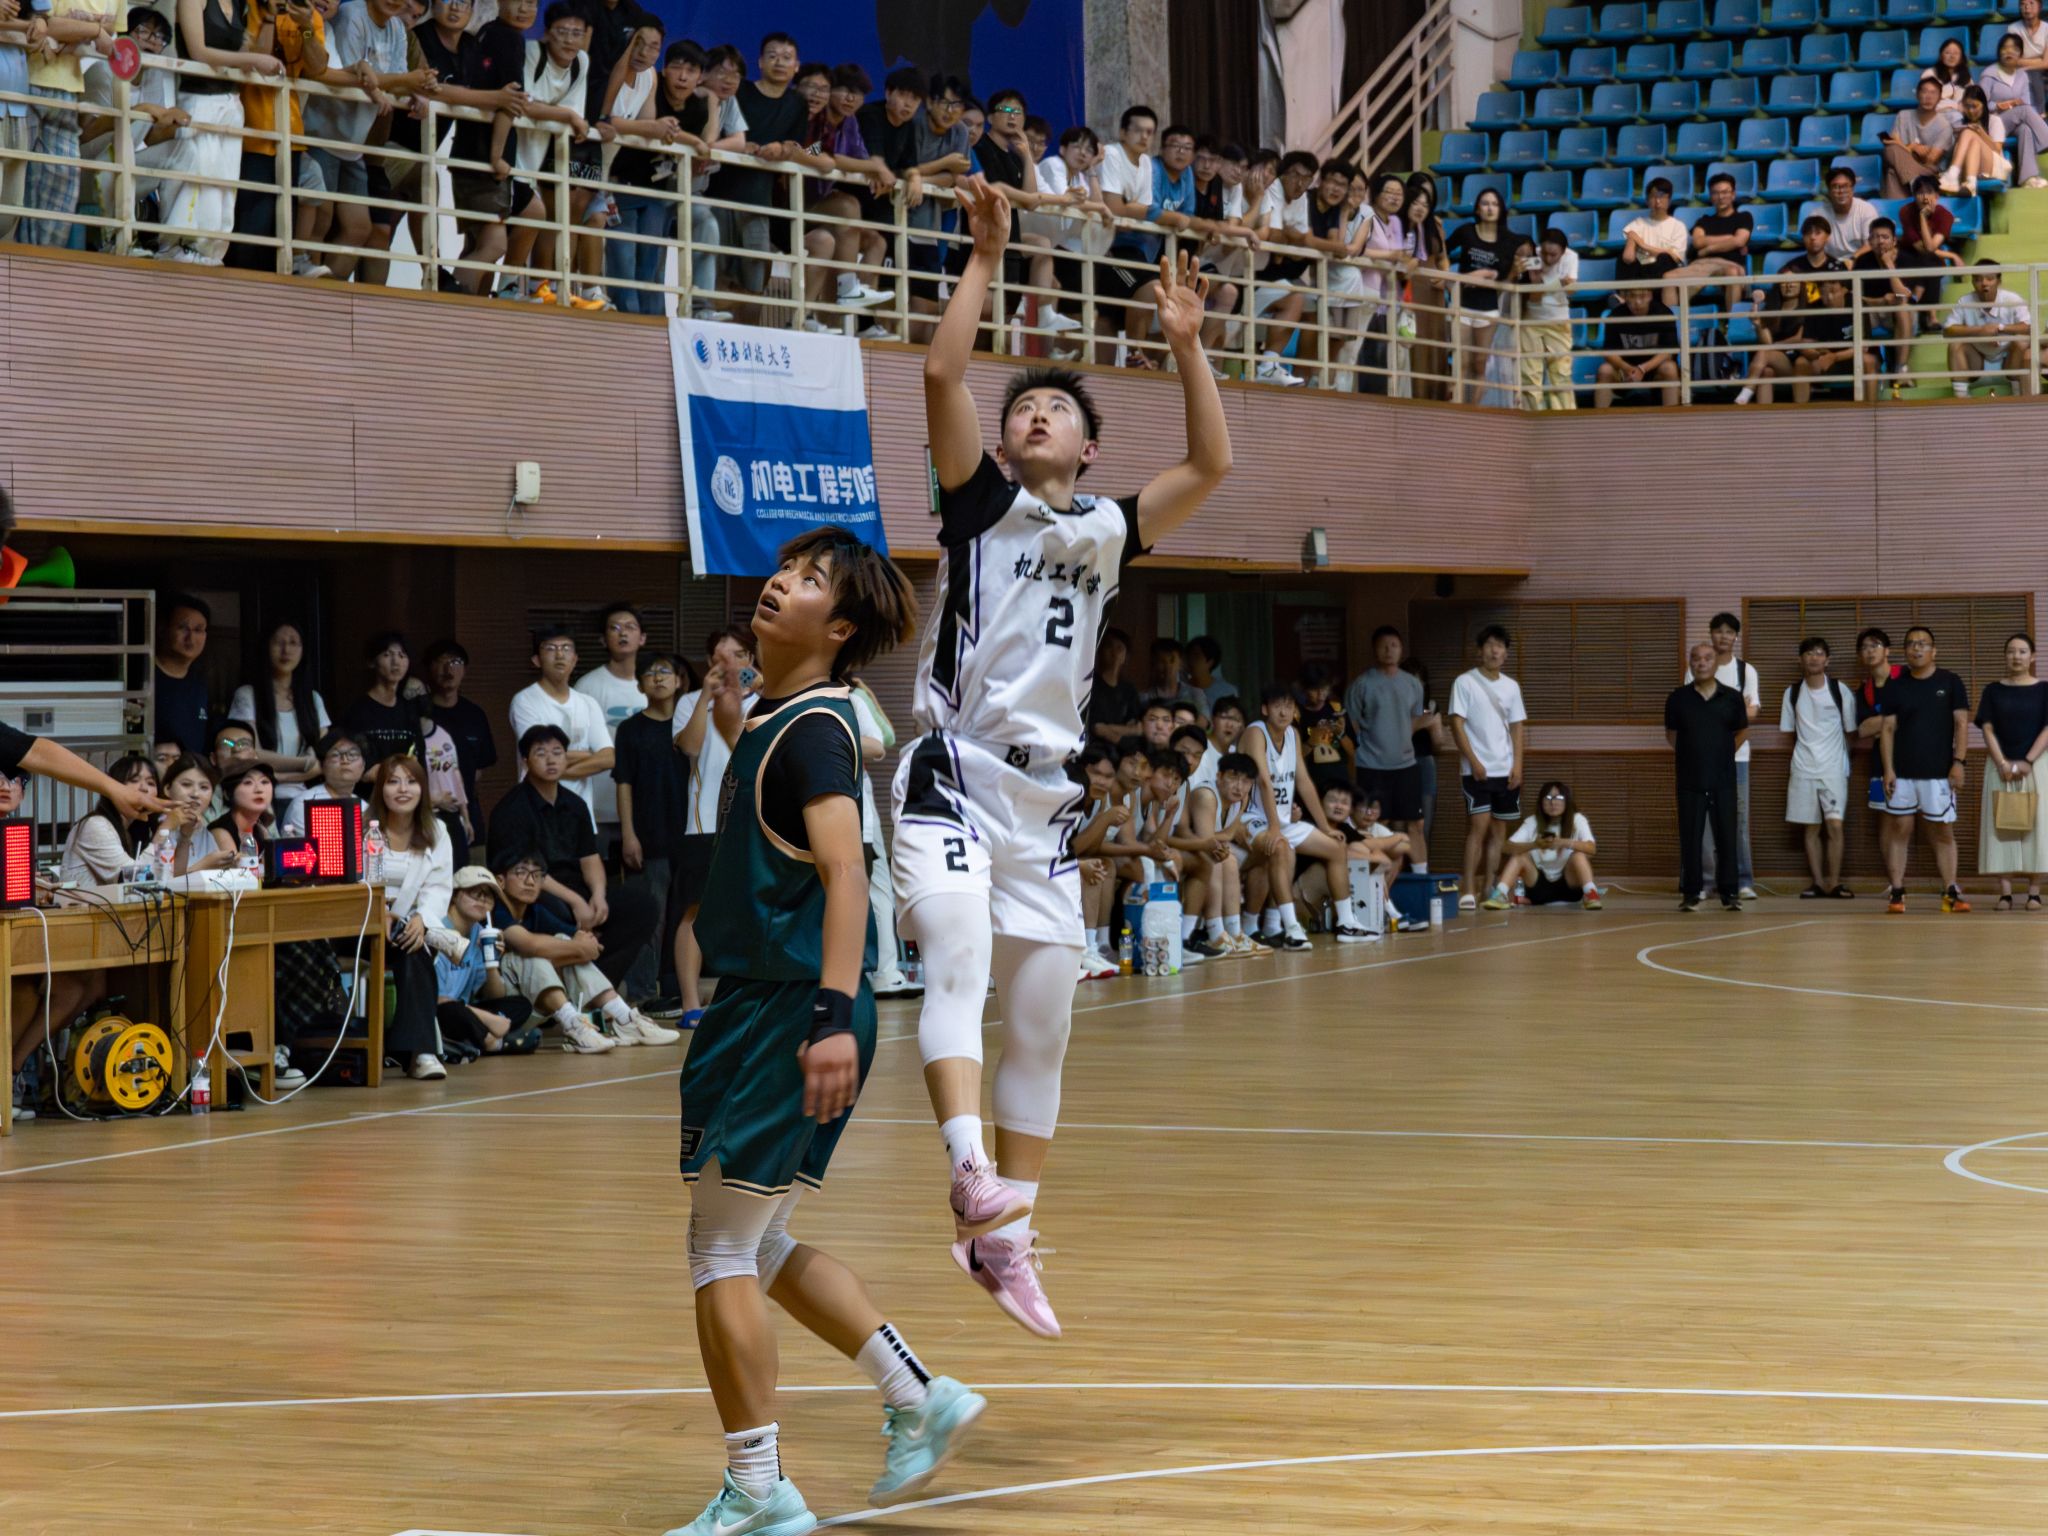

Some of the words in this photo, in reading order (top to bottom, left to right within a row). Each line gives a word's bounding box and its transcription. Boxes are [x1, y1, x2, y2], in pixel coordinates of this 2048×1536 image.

[750, 460, 876, 506] 机电工程学院
[1046, 595, 1075, 650] 2
[943, 837, 969, 872] 2
